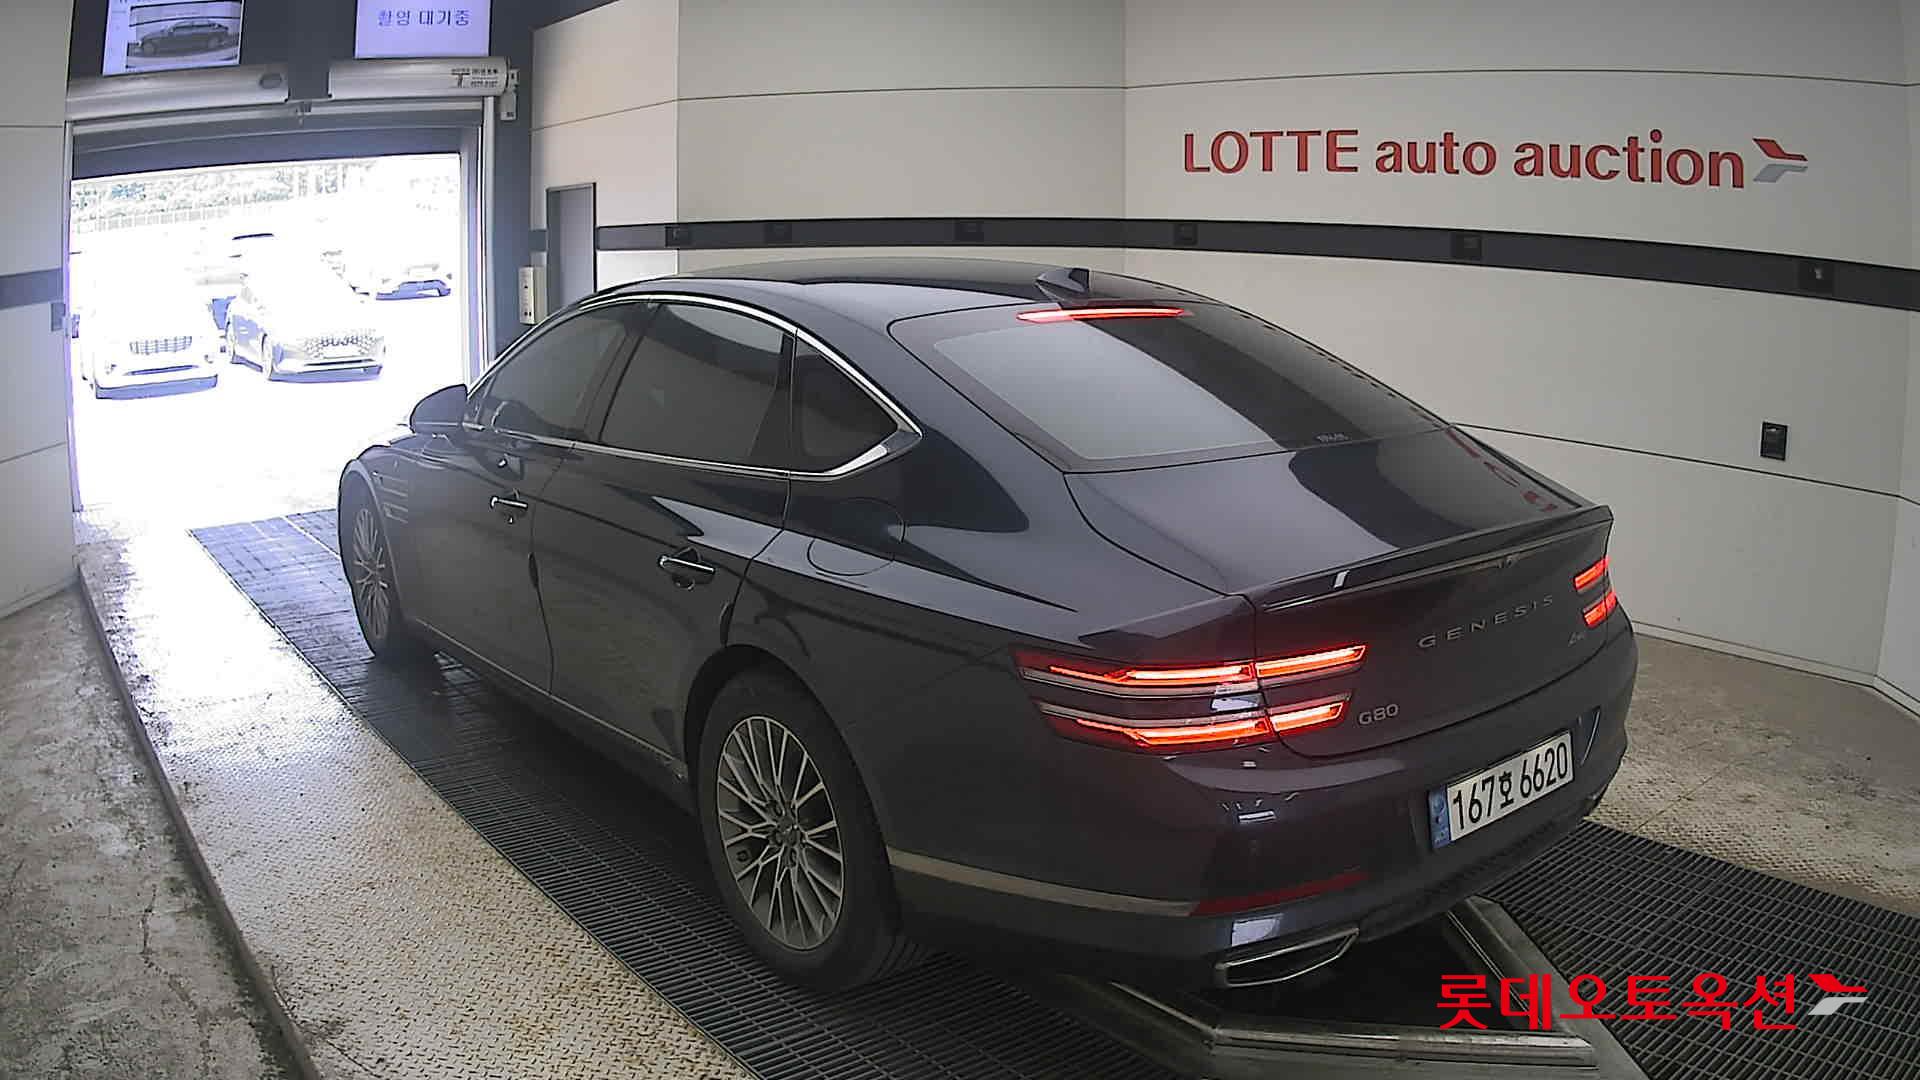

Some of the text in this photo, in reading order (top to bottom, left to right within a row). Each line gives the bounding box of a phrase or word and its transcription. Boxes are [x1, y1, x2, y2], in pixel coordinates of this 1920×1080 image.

[1184, 129, 1744, 189] LOTTE auto auction
[1417, 595, 1553, 649] GENESIS
[1358, 703, 1400, 726] G80
